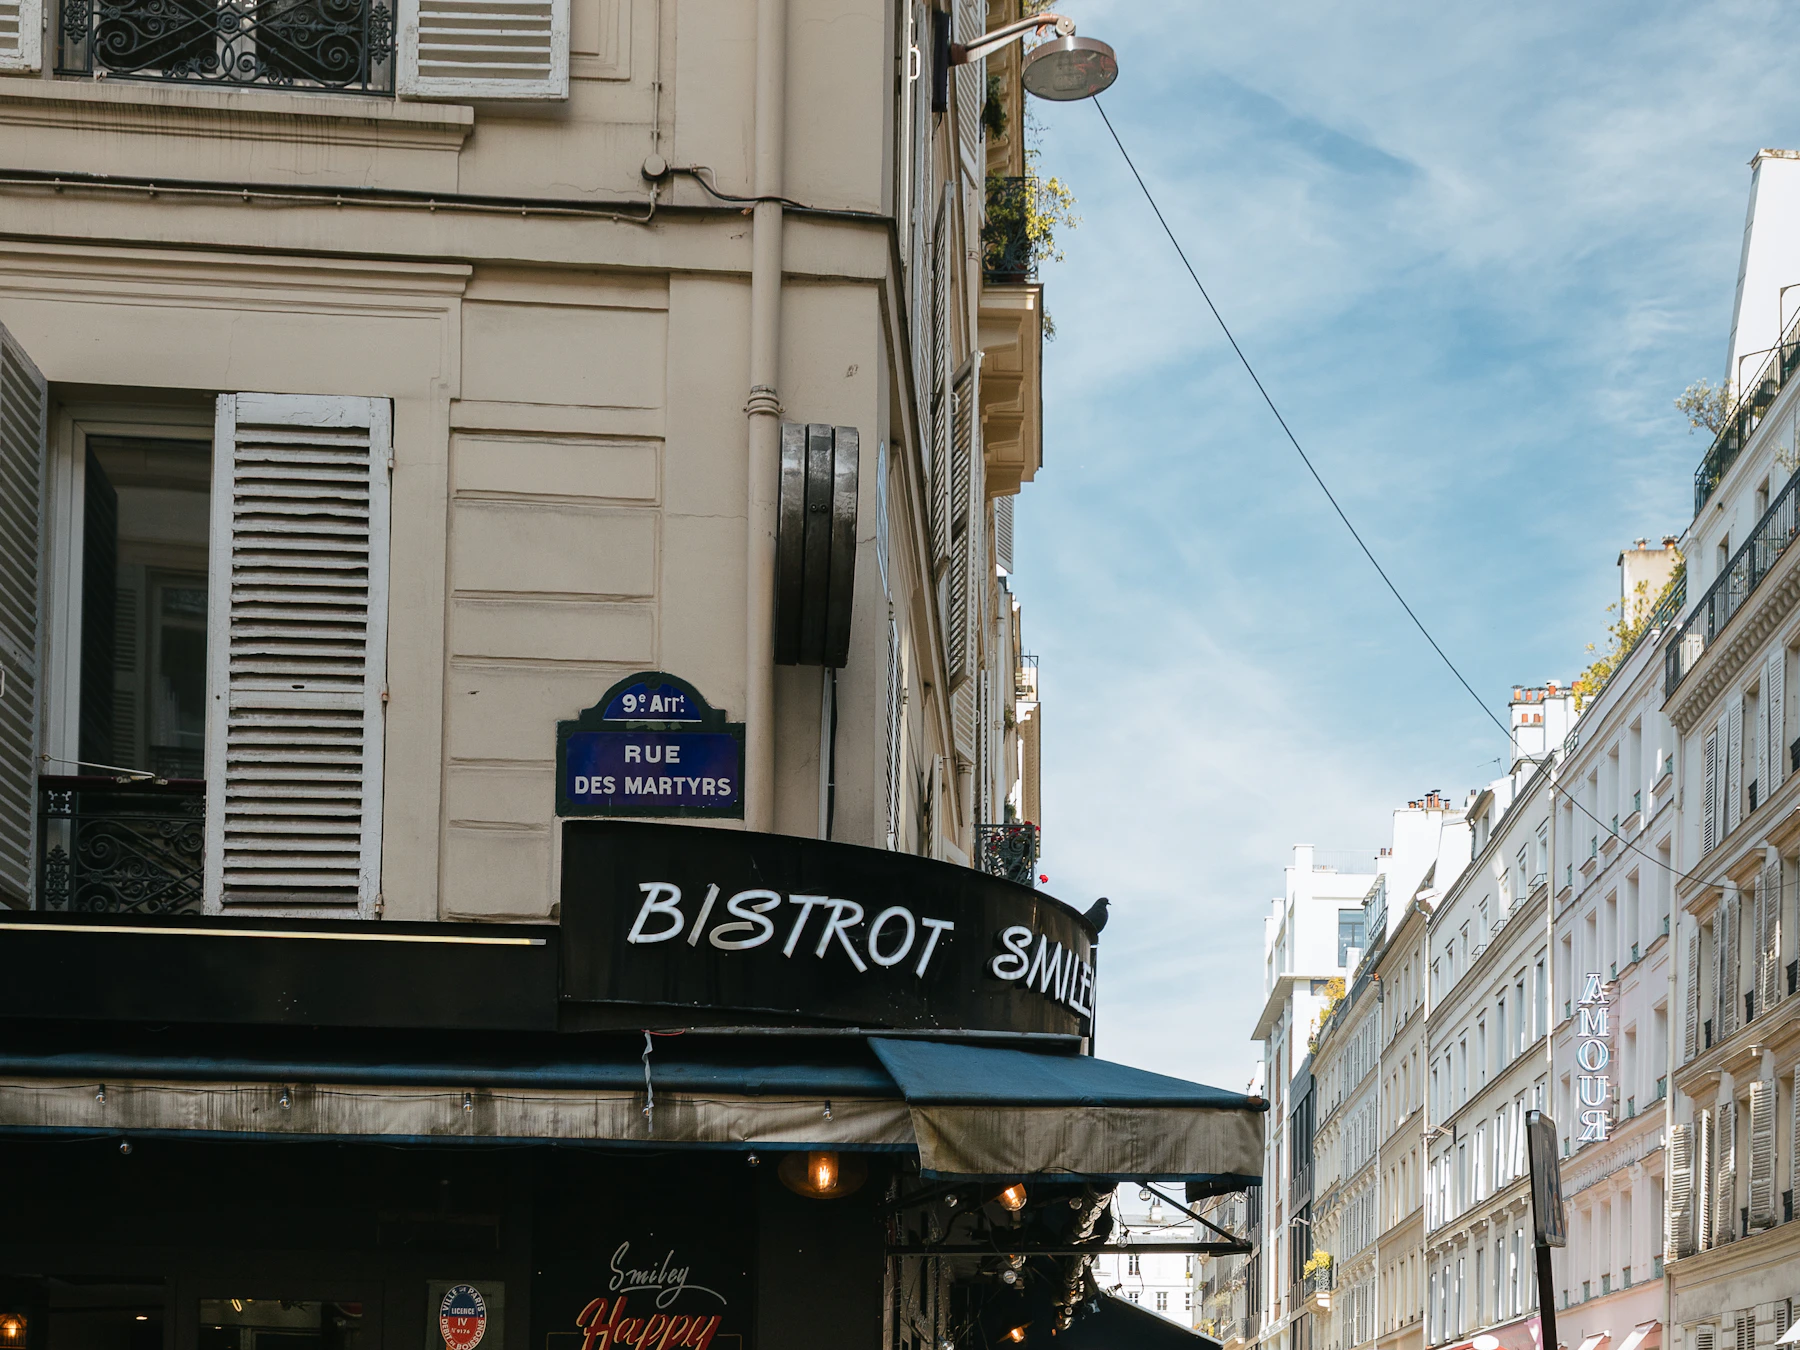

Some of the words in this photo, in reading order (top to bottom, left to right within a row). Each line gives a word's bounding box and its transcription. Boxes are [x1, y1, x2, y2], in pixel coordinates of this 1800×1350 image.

[624, 745, 681, 764] RUE
[574, 775, 616, 795] DES
[624, 776, 732, 796] MARTYRS
[626, 881, 955, 979] BISTROT
[609, 1240, 727, 1309] Smiley
[442, 1288, 458, 1311] VILLE
[467, 1287, 485, 1312] PARIS
[451, 1307, 475, 1315] LICENCE
[457, 1317, 469, 1326] IV
[441, 1318, 453, 1341] DEBIT
[456, 1318, 485, 1350] BOISSONS
